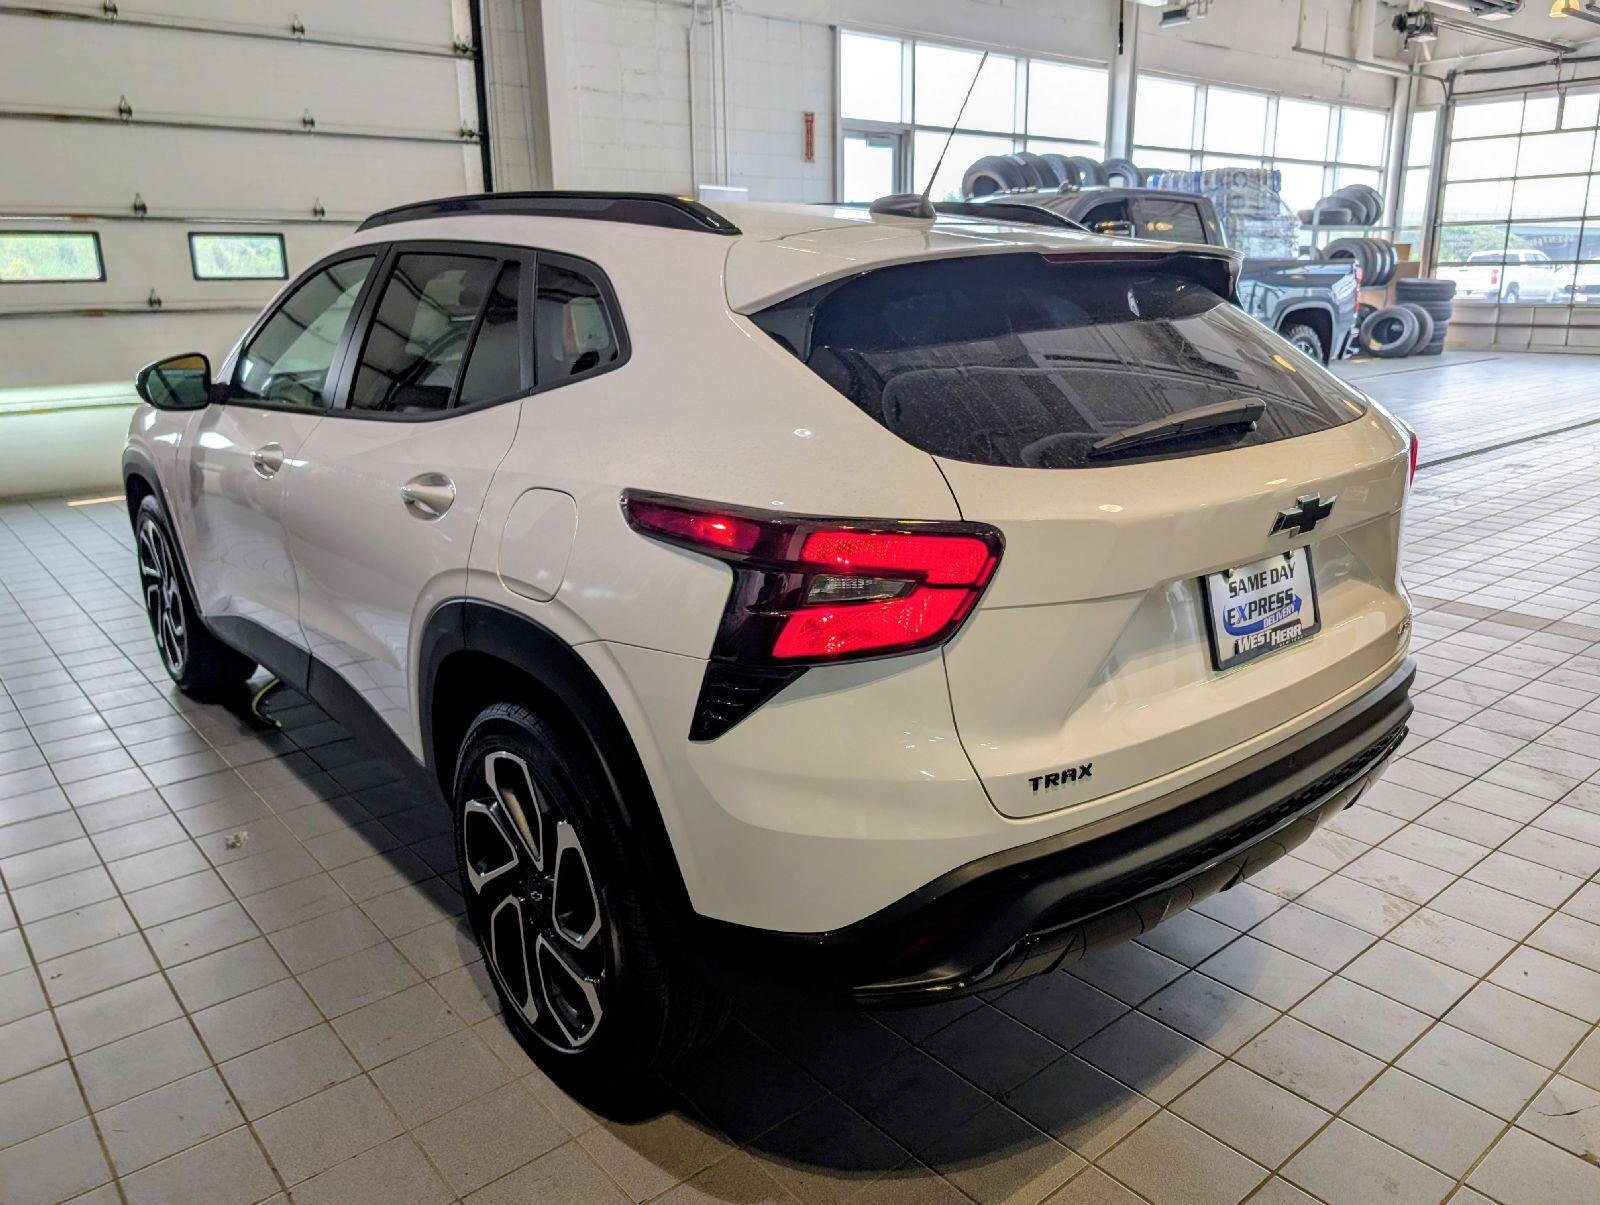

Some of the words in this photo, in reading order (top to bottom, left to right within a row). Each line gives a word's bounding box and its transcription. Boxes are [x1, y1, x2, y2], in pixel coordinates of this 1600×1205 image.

[1228, 571, 1268, 598] SAME
[1270, 561, 1295, 585] DAY
[1226, 587, 1294, 626] EXPRESS
[1263, 602, 1295, 628] DELIVERY
[1028, 762, 1093, 791] TRAX
